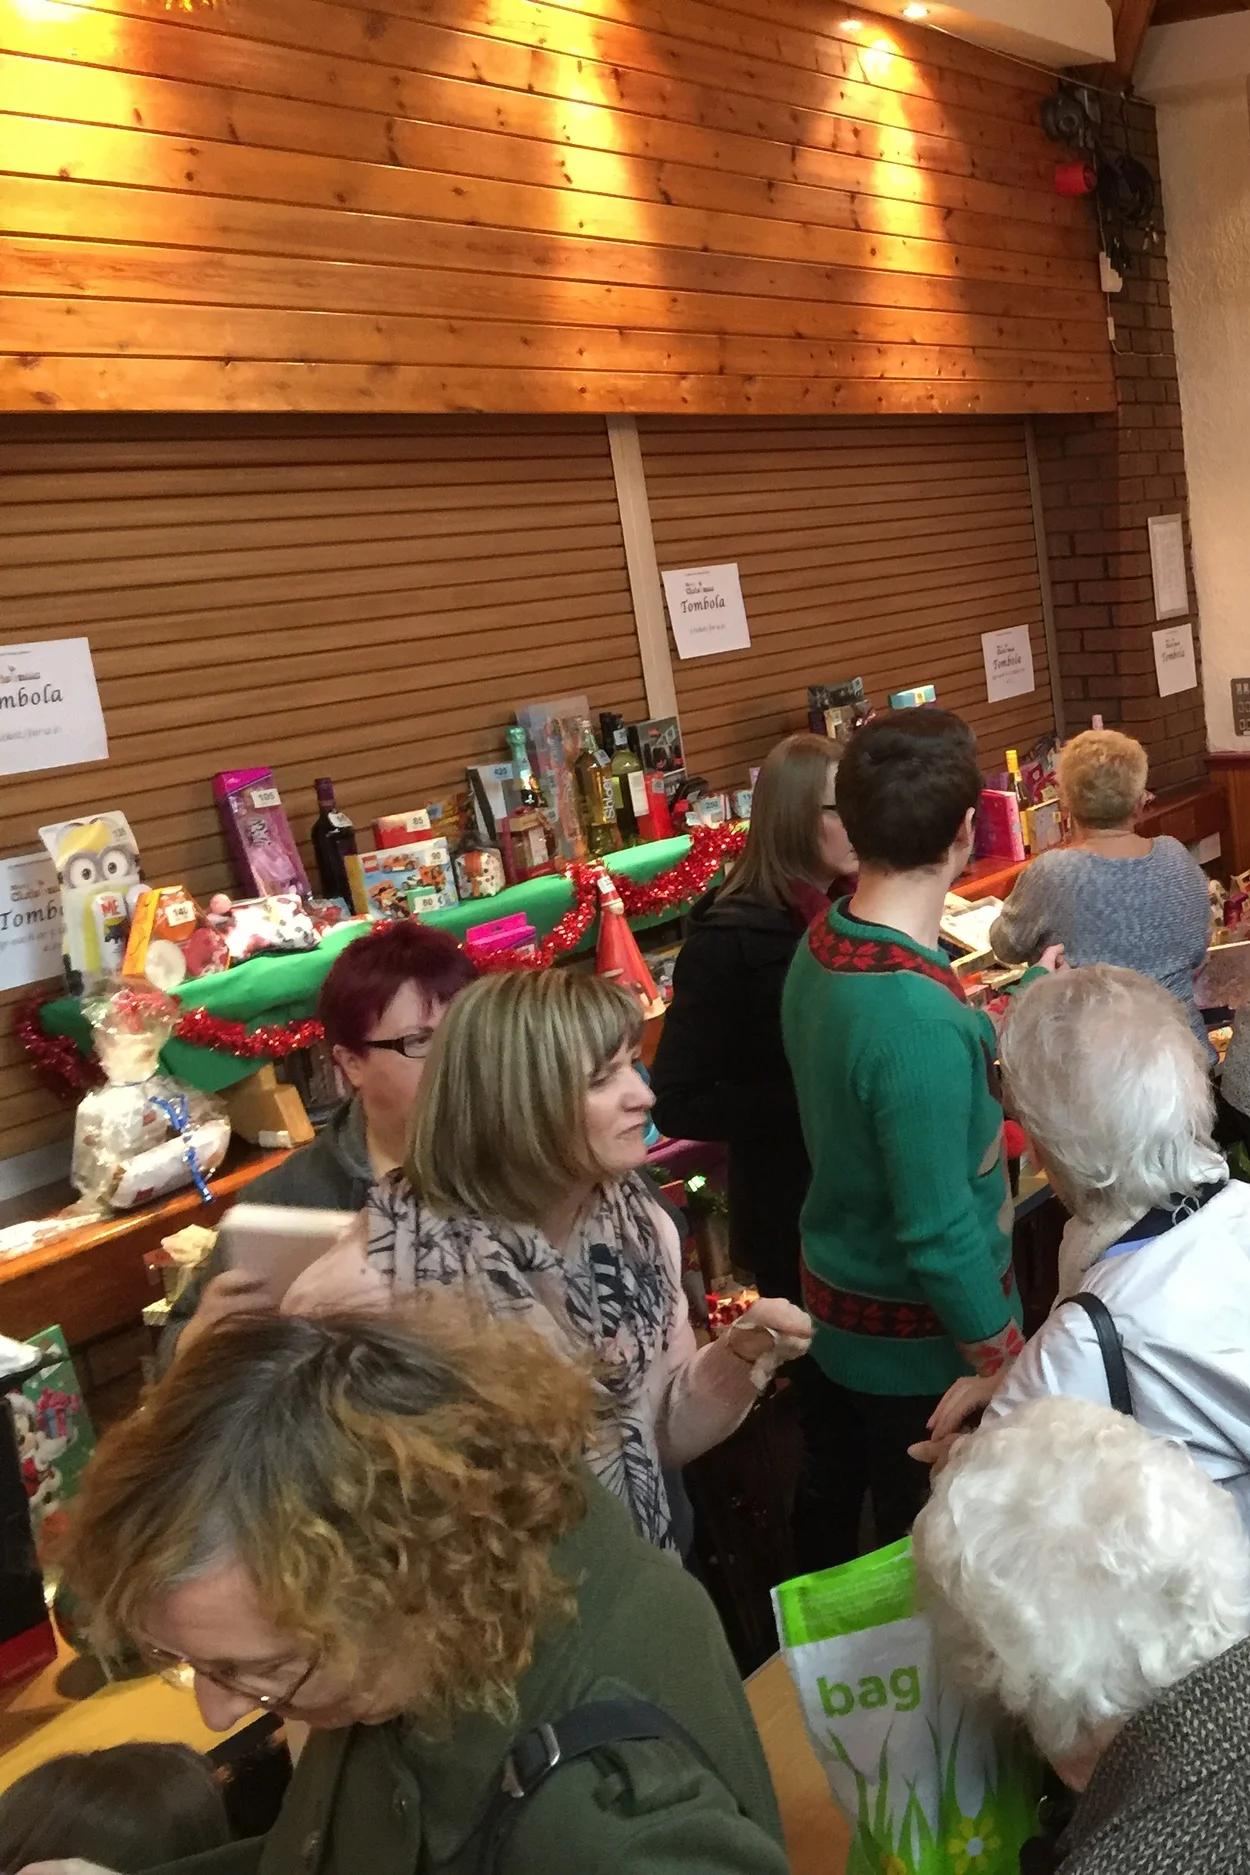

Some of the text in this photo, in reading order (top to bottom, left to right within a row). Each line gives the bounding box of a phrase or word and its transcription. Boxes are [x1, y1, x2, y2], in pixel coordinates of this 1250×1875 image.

[680, 594, 726, 614] Tombola
[992, 652, 1022, 671] Tombola
[258, 791, 276, 802] 105
[600, 776, 617, 822] Shloer
[704, 800, 720, 810] 250
[412, 815, 425, 826] 85
[430, 850, 442, 861] 90
[816, 1664, 922, 1719] bag
